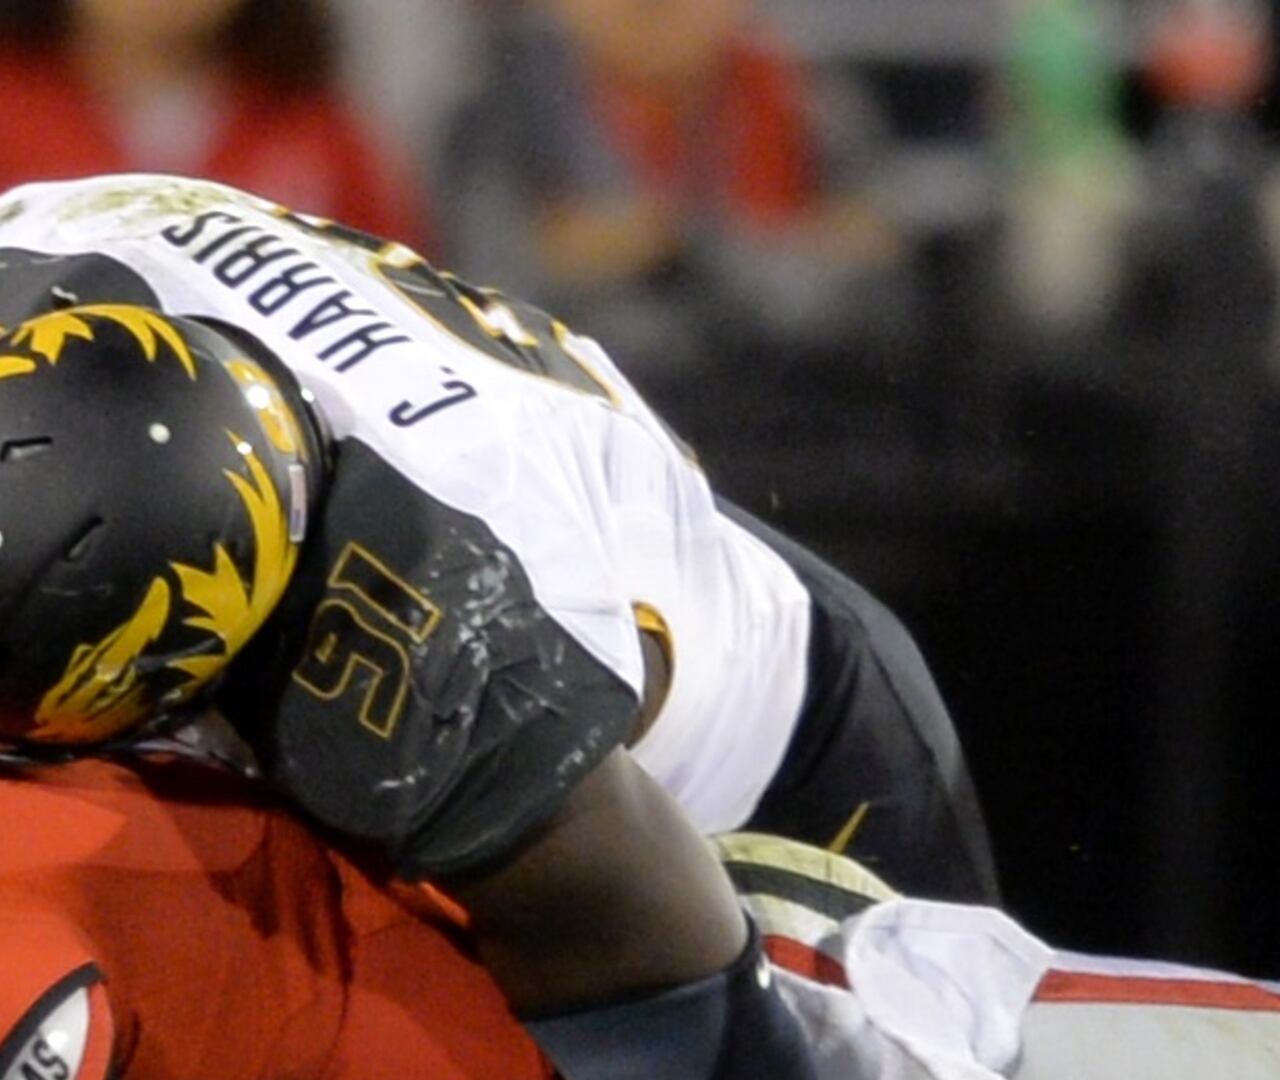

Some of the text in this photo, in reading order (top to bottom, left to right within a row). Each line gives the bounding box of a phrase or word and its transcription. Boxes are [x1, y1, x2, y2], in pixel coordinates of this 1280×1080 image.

[160, 210, 414, 374] HARRIS
[387, 366, 479, 428] C.
[292, 541, 441, 738] 91
